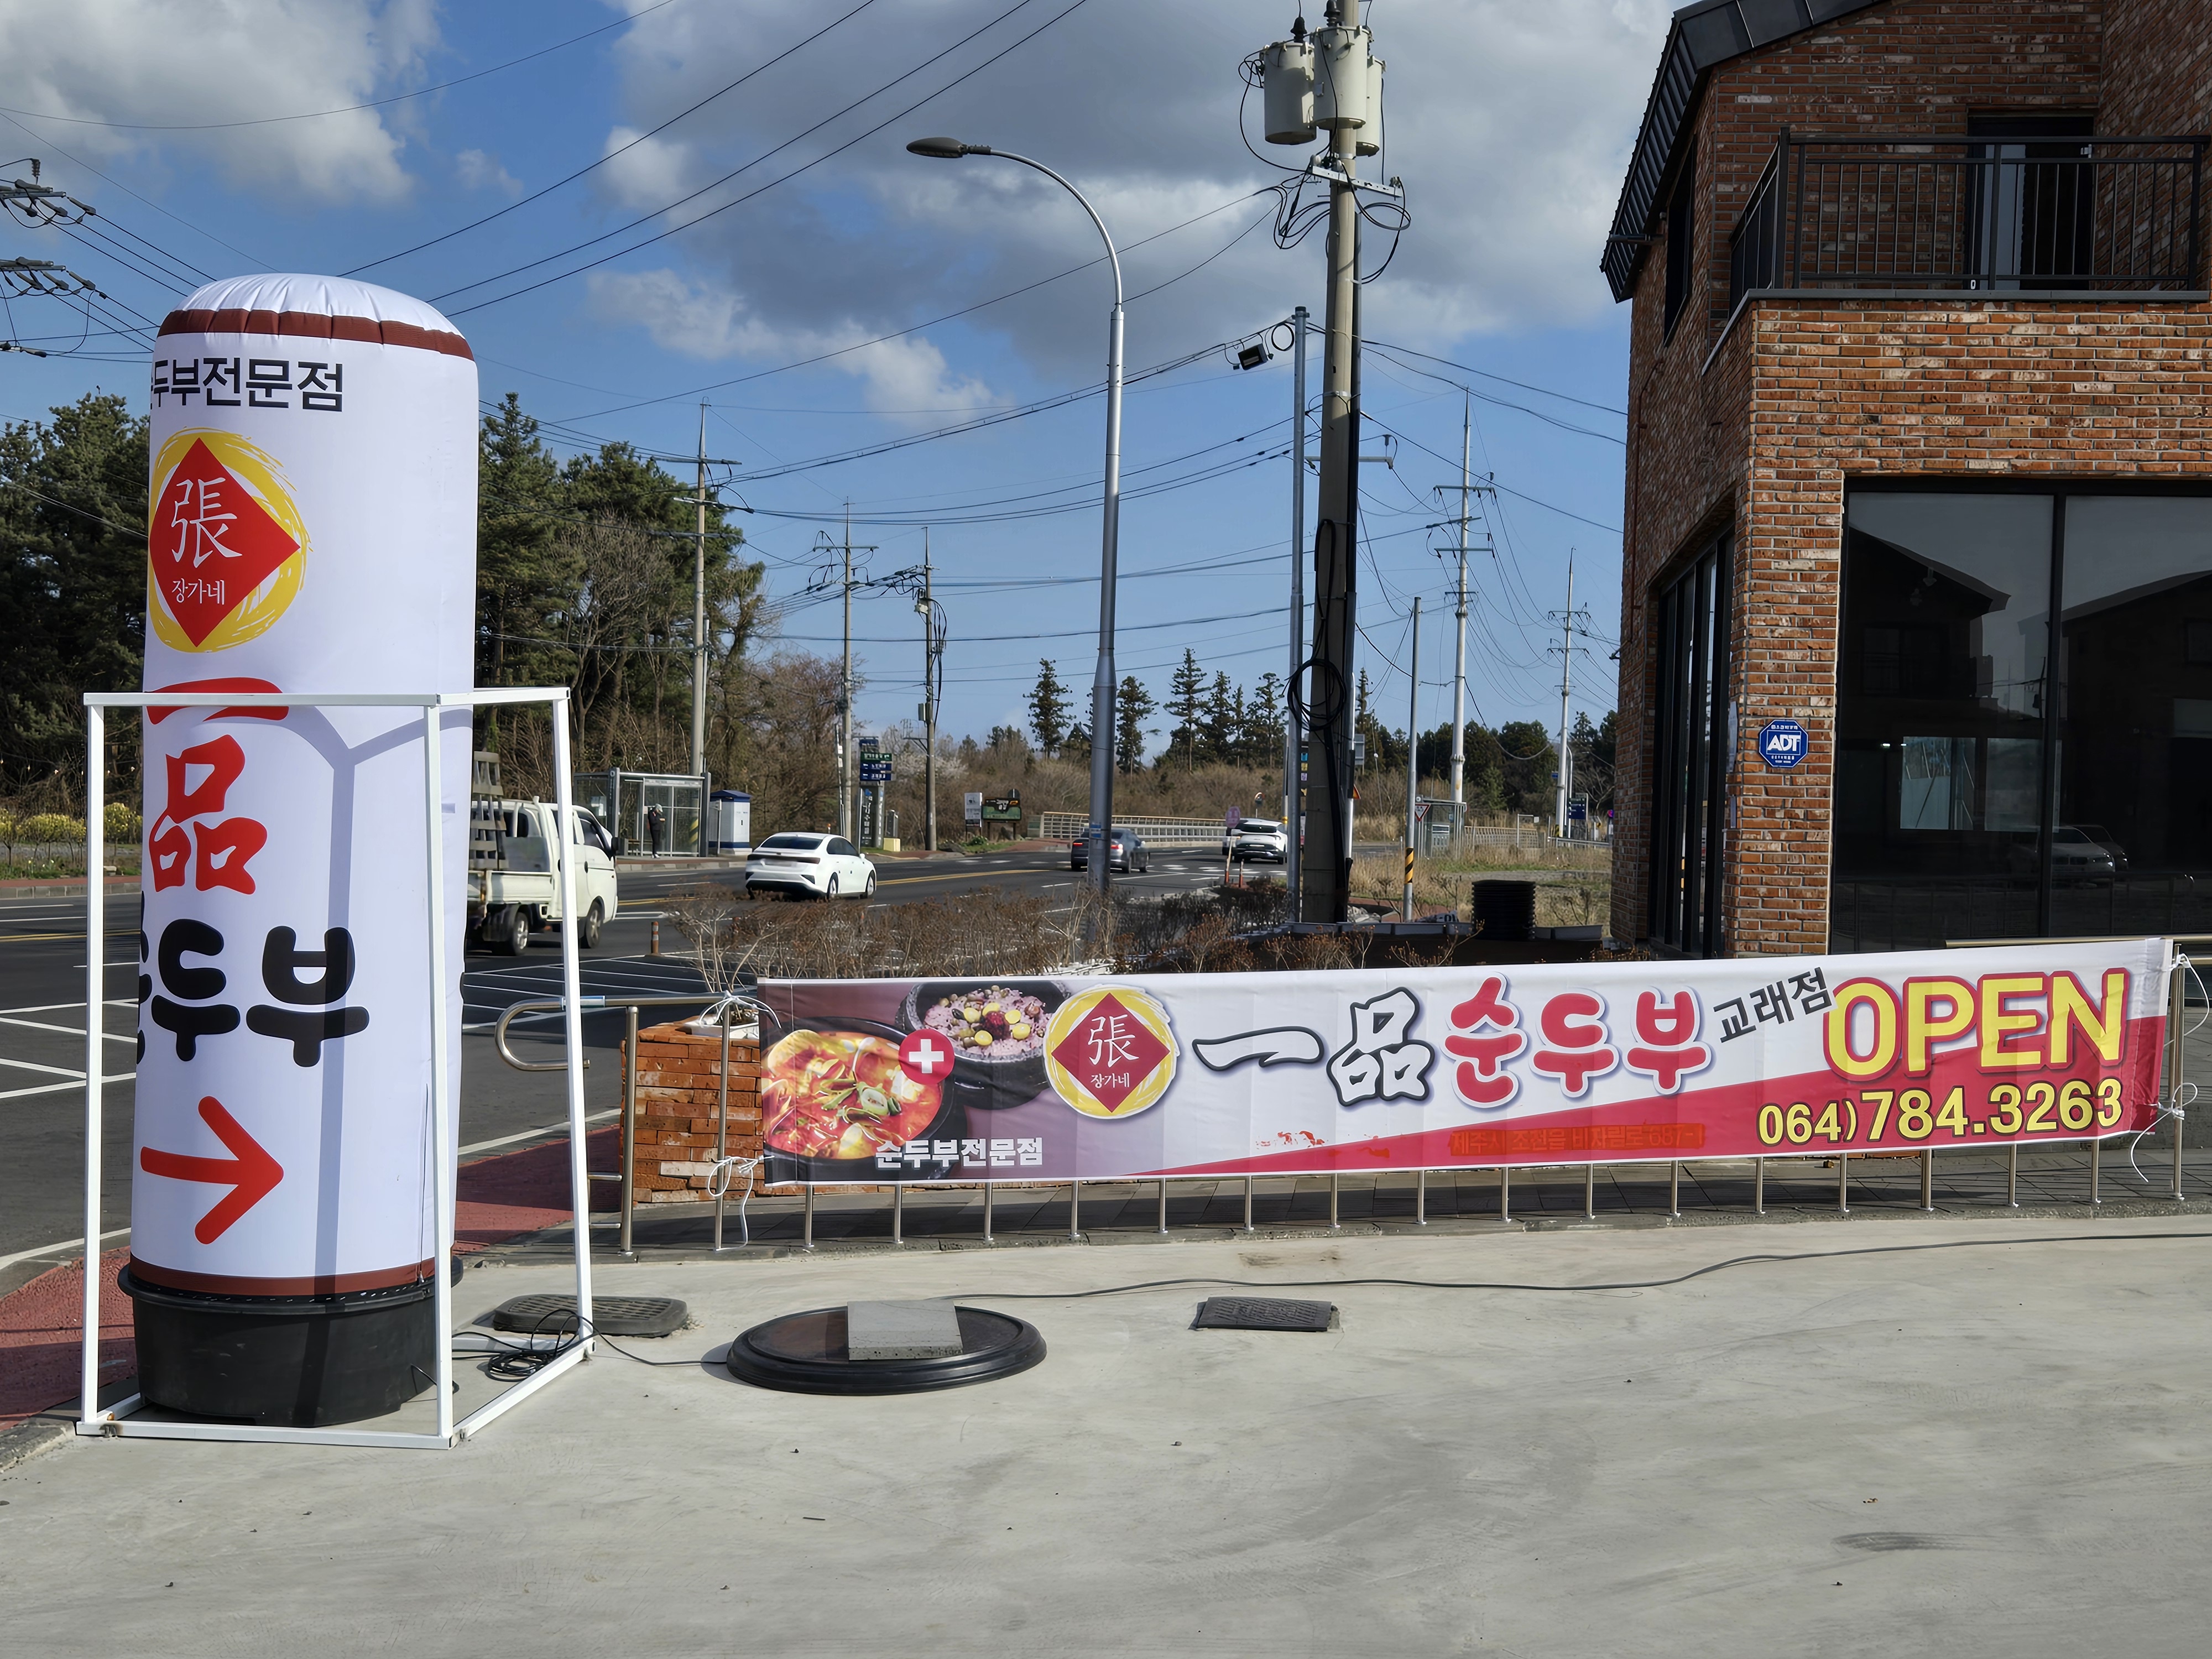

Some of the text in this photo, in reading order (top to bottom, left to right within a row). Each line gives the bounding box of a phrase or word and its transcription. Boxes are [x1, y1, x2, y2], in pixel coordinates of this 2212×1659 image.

[150, 357, 343, 412] 두부전문점
[171, 477, 243, 568] 張
[171, 578, 225, 605] 장가네
[1767, 734, 1801, 752] ADT
[136, 890, 369, 1067] 두부
[1713, 967, 1833, 1044] 교래점
[1087, 1014, 1140, 1068] 張
[1824, 968, 2129, 1079] OPEN
[1091, 1072, 1130, 1089] 장가네
[1757, 1078, 2122, 1146] 064)784.3263
[875, 1137, 1043, 1169] 순두부전문점
